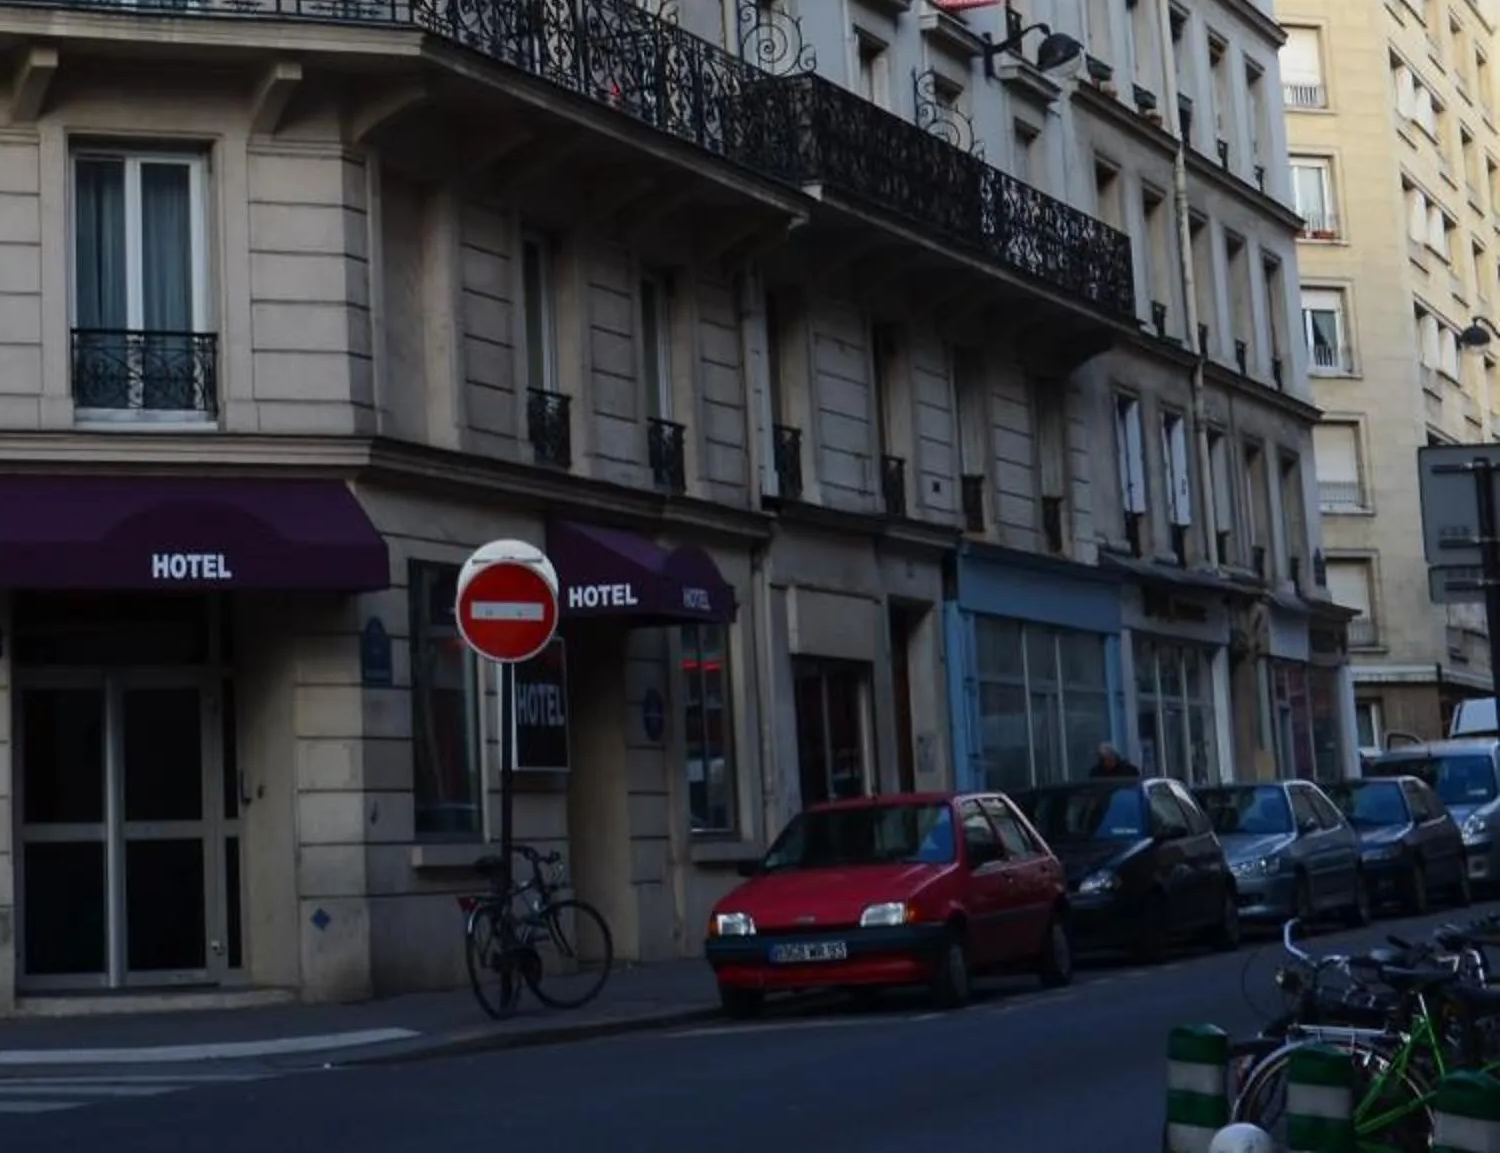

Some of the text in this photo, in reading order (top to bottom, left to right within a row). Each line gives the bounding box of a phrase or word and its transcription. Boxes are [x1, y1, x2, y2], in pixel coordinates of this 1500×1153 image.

[152, 553, 232, 579] HOTEL
[568, 583, 638, 608] HOTEL
[683, 588, 711, 610] HOTEL
[516, 682, 566, 726] HOTEL
